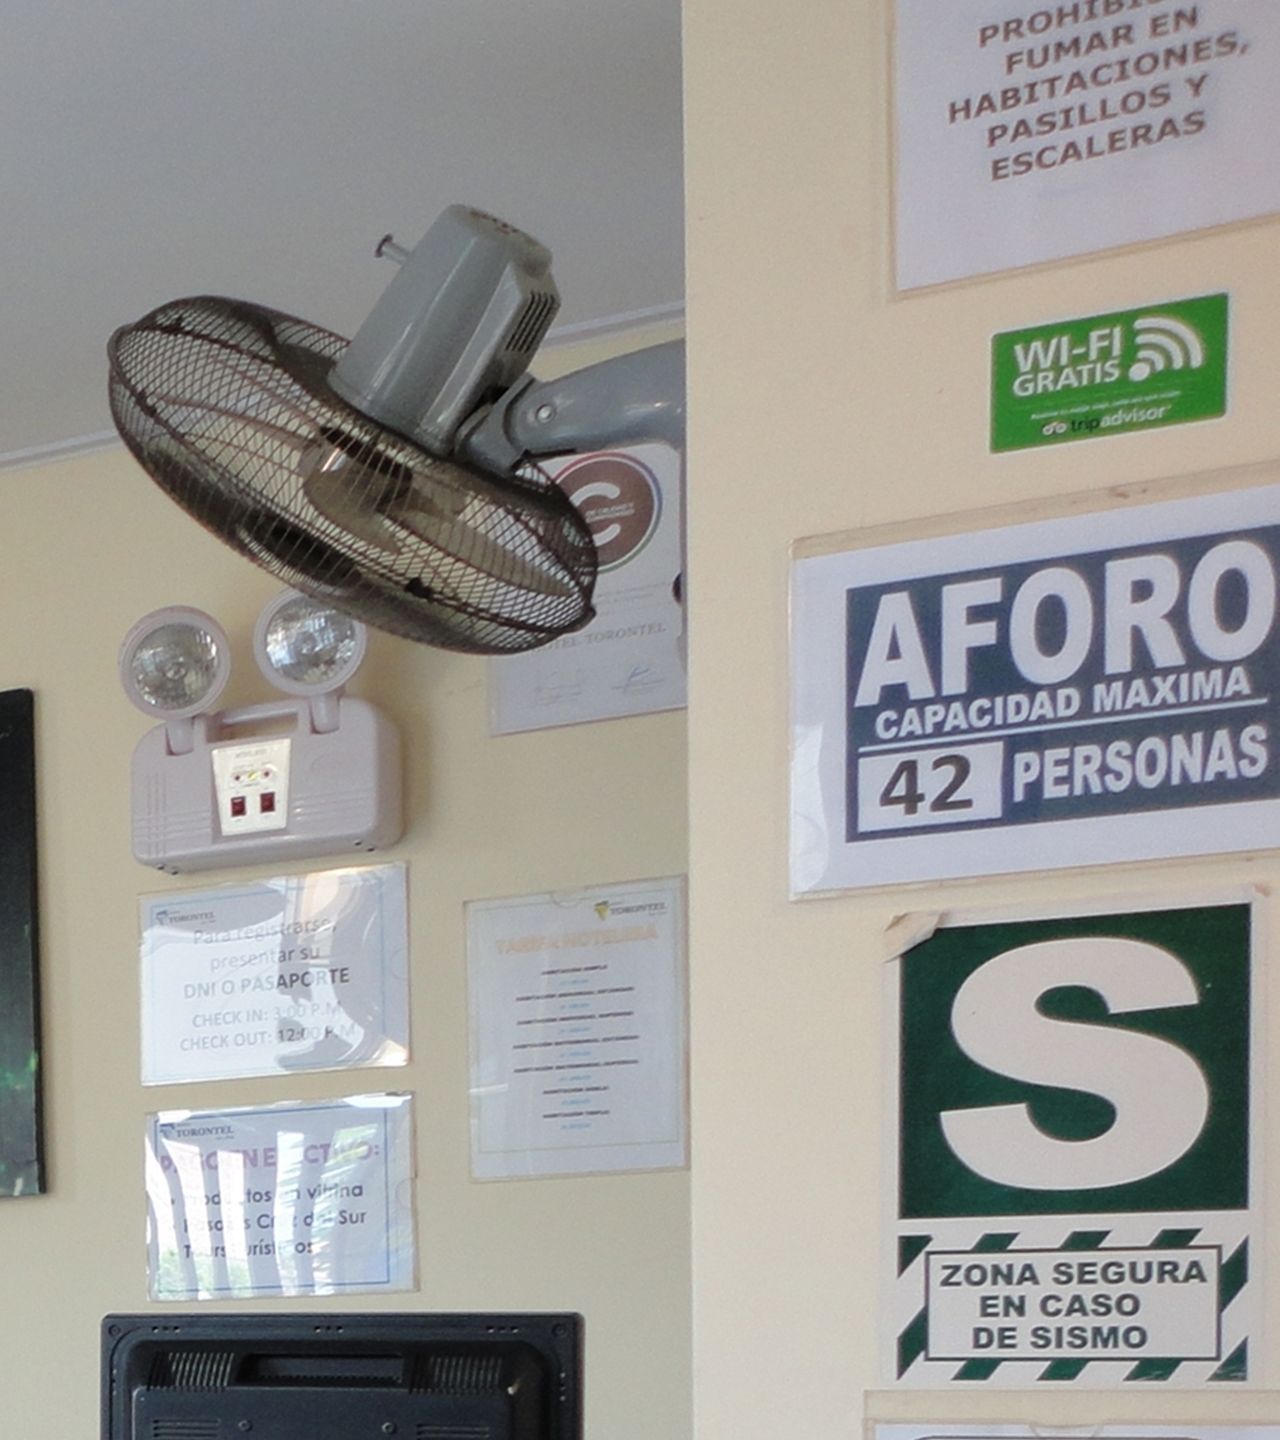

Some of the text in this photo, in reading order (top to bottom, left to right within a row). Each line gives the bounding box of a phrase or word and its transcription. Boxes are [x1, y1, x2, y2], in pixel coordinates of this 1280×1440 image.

[978, 0, 1165, 48] PROHIB
[1005, 6, 1199, 75] FUMAR EN
[947, 31, 1250, 123] HABITACIONES,
[986, 74, 1210, 147] PASILLOS Y
[991, 110, 1207, 181] ESCALERAS
[1013, 325, 1122, 373] WI-FI
[1012, 359, 1121, 397] GRATIS
[854, 540, 1278, 707] AFORO
[875, 666, 1251, 740] CAPACIDAD MAXIMA
[878, 722, 1269, 816] 42 PERSONAS
[299, 947, 321, 960] su
[183, 967, 351, 1000] DNI O PASAPORTE
[191, 1009, 243, 1028] CHECK
[246, 1006, 269, 1022] IN:
[179, 1034, 230, 1052] CHECK
[233, 1031, 273, 1048] OUT:
[940, 937, 1210, 1191] S
[338, 1209, 367, 1225] Sur
[939, 1260, 1208, 1287] ZONA SEGURA
[978, 1293, 1141, 1318] EN CASO
[972, 1325, 1149, 1350] DE SISMO
